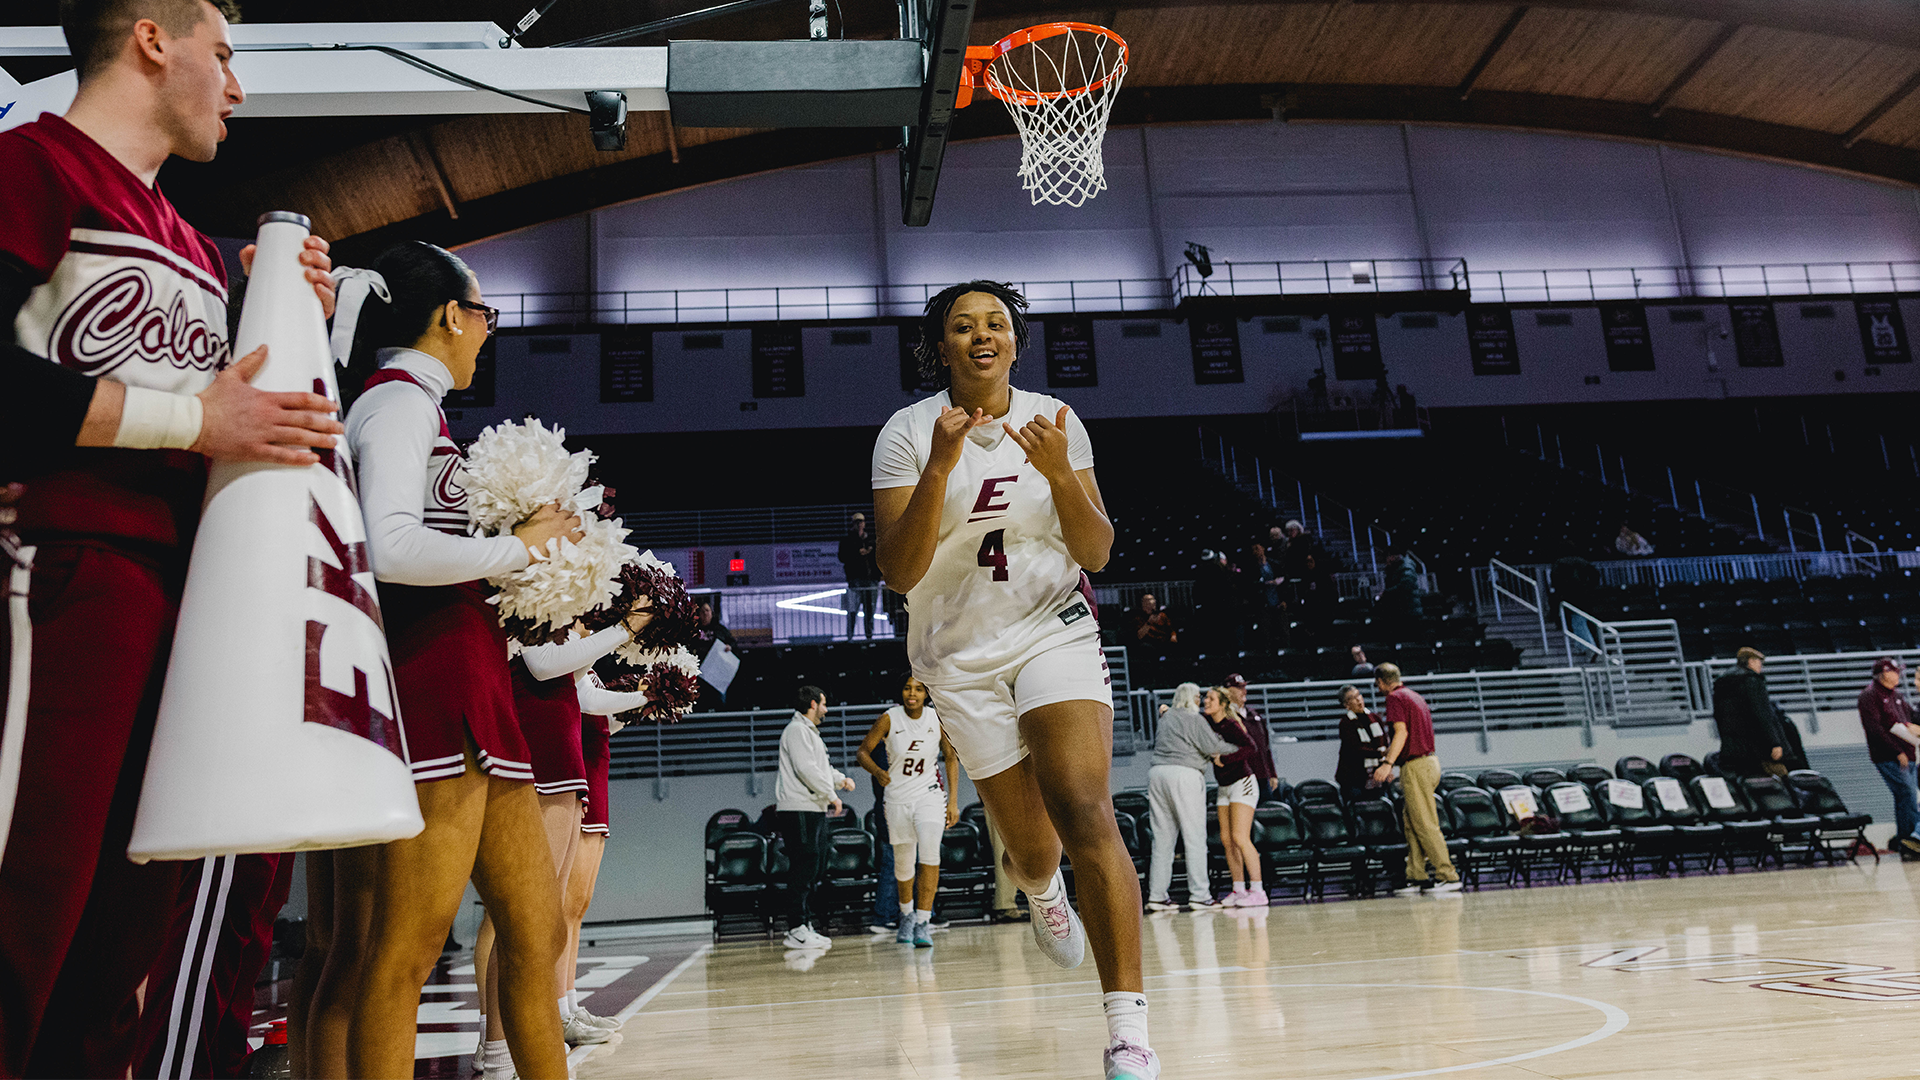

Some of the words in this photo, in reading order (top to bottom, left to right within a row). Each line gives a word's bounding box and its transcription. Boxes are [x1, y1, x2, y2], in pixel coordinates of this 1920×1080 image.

[970, 474, 1019, 514] E
[977, 528, 1009, 582] 4
[907, 740, 924, 752] E
[902, 758, 925, 777] 24
